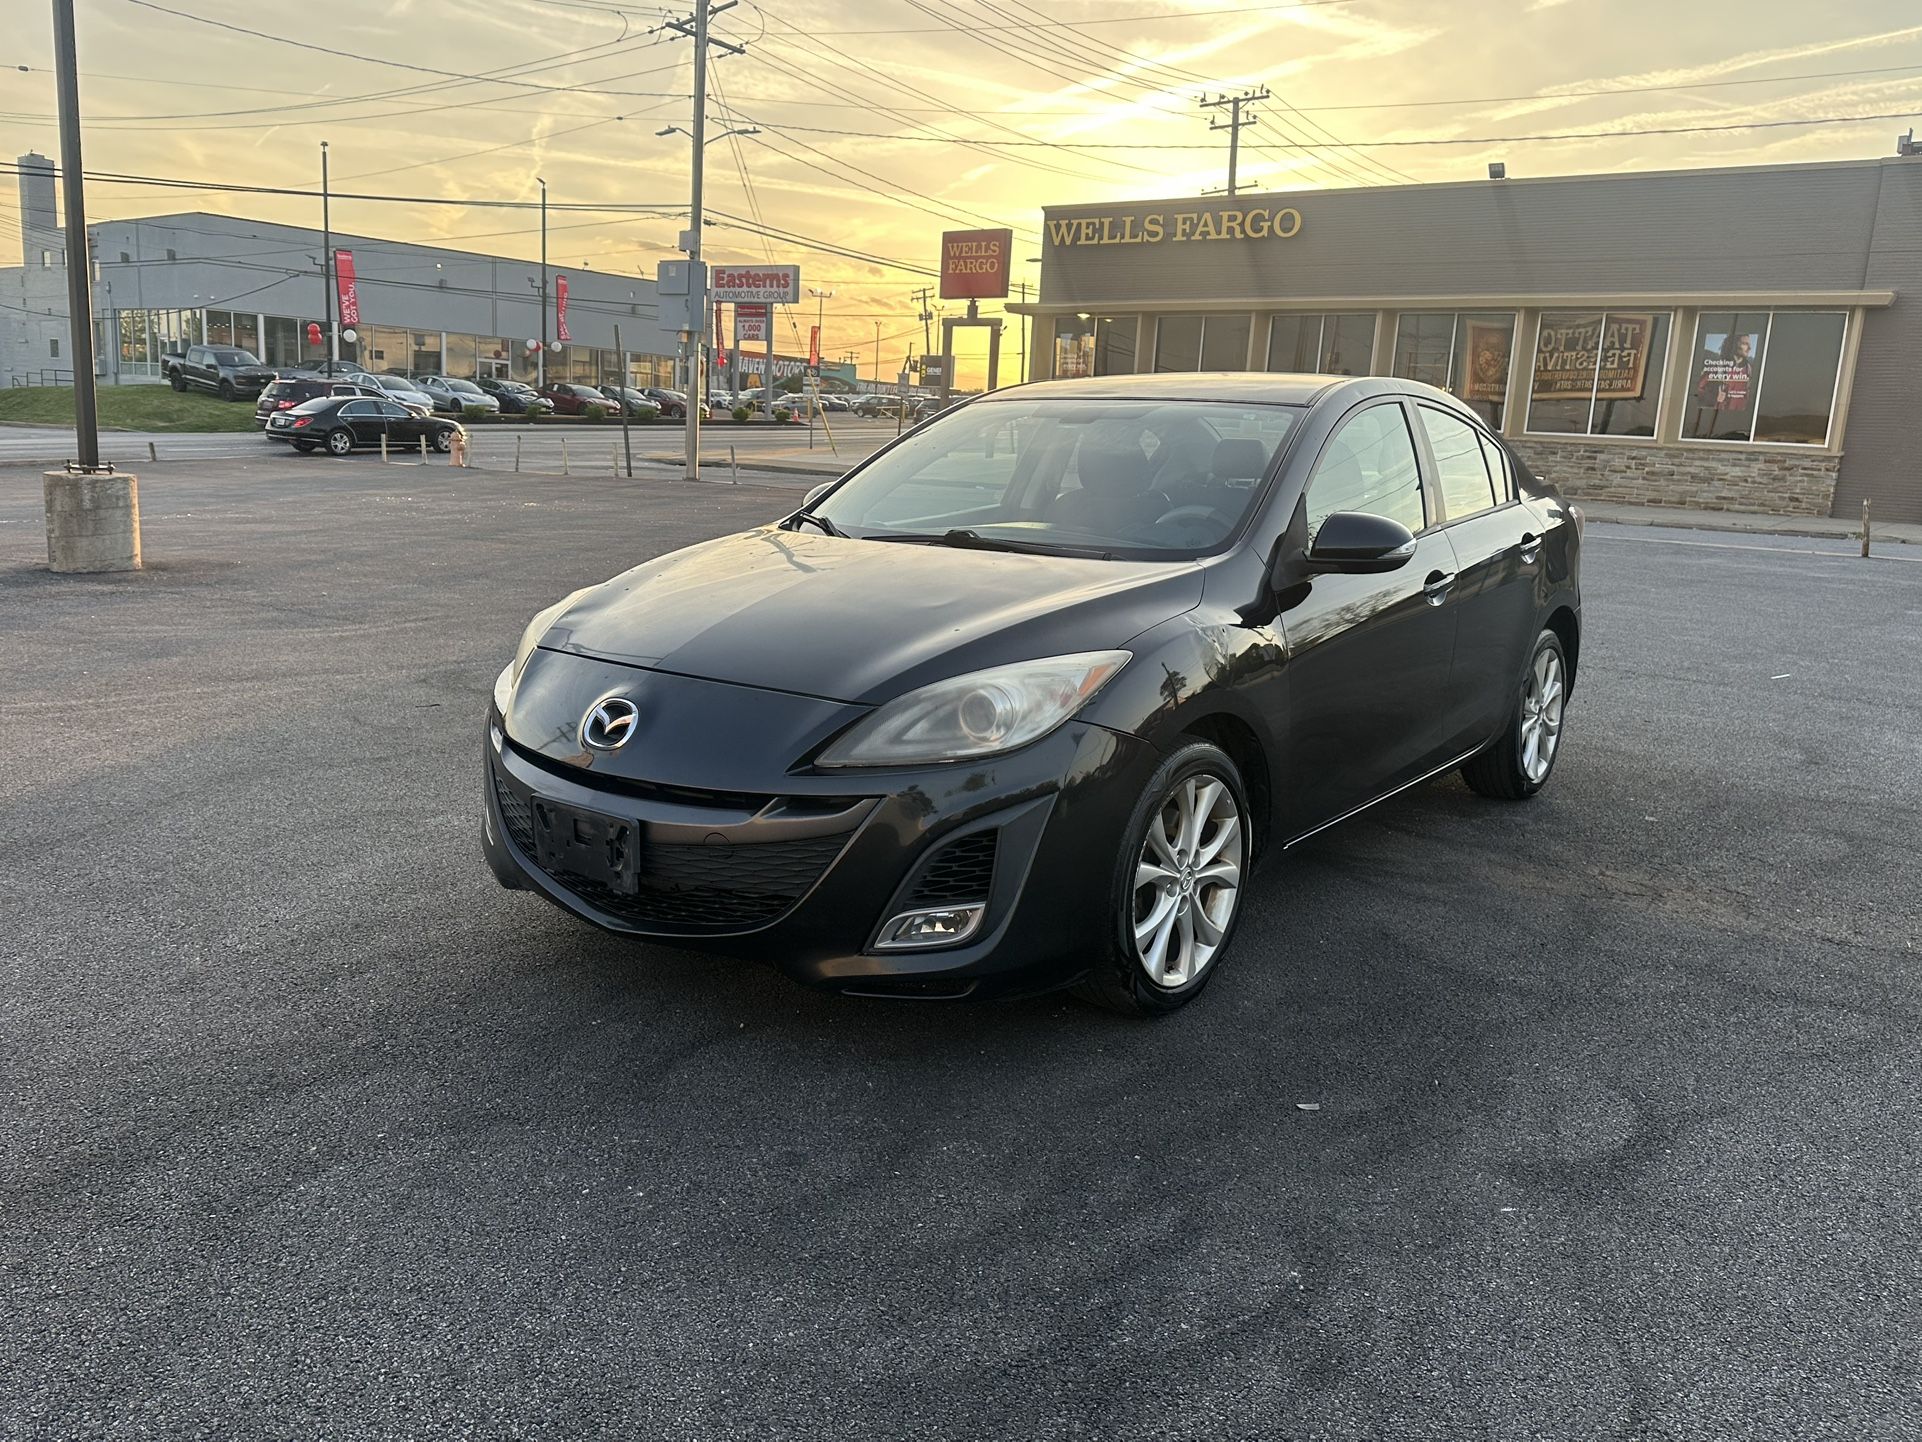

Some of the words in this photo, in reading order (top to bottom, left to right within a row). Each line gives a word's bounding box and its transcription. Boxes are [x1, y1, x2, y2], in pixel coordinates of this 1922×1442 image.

[1047, 214, 1164, 246] WELLS
[1172, 208, 1302, 241] FARGO
[947, 241, 999, 256] WELLS
[947, 258, 998, 273] FARGO
[714, 269, 790, 289] Easterns
[714, 290, 761, 299] AUTOMOTIVE
[762, 290, 789, 299] GROUP
[350, 305, 358, 323] GOT
[742, 324, 761, 332] 1,000
